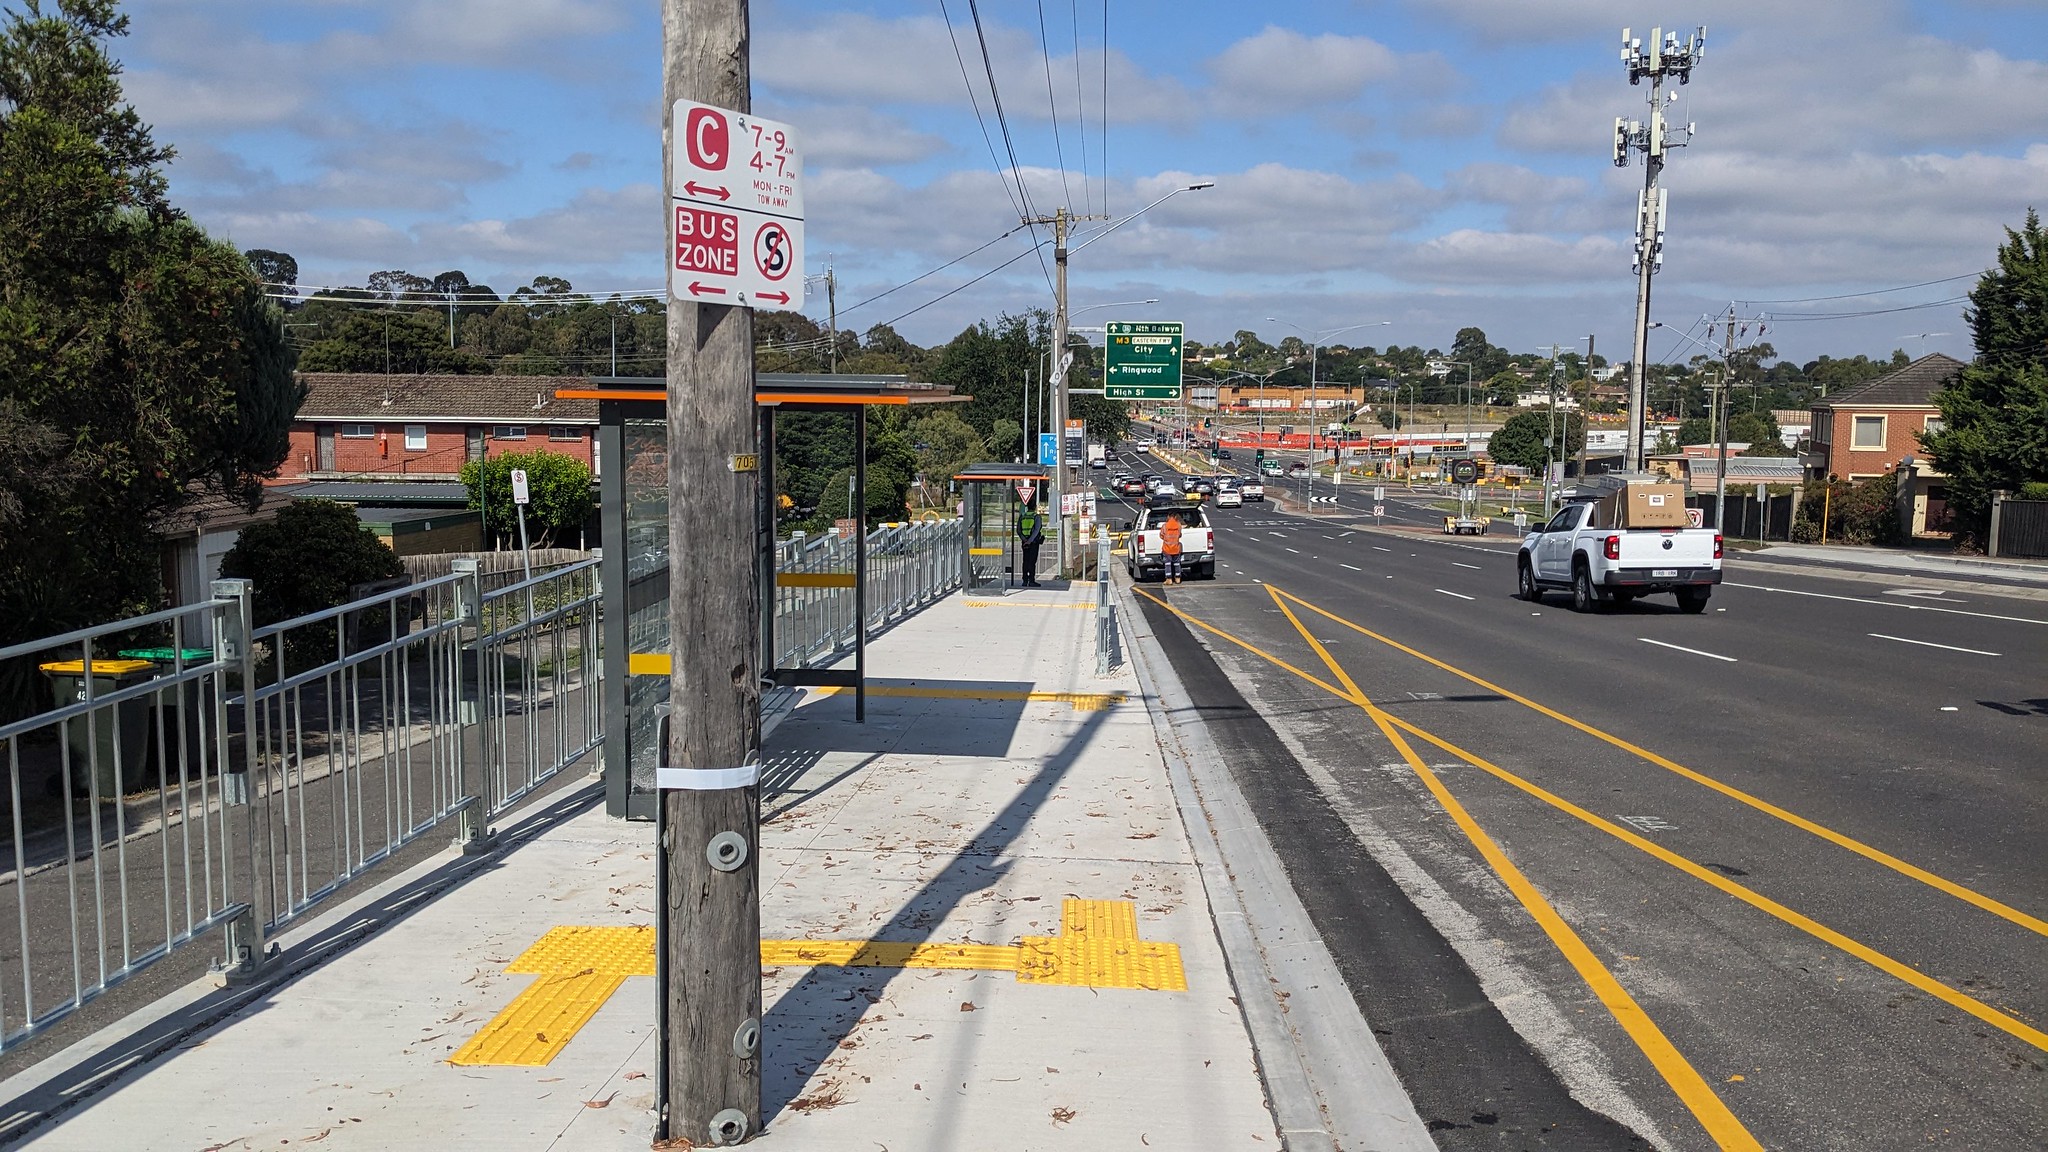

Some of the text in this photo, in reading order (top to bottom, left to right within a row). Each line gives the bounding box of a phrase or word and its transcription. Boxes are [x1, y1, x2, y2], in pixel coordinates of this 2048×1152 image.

[697, 115, 719, 164] C
[751, 124, 794, 156] 7-9 AM
[750, 151, 795, 180] 4-7 PM
[753, 179, 772, 192] MON
[780, 184, 793, 196] FRI
[757, 193, 789, 209] TOW AWAY
[679, 211, 736, 242] BUS
[679, 243, 736, 272] ZONE
[1135, 346, 1153, 354] City
[1122, 366, 1162, 375] Ringwood
[1113, 388, 1145, 396] High St
